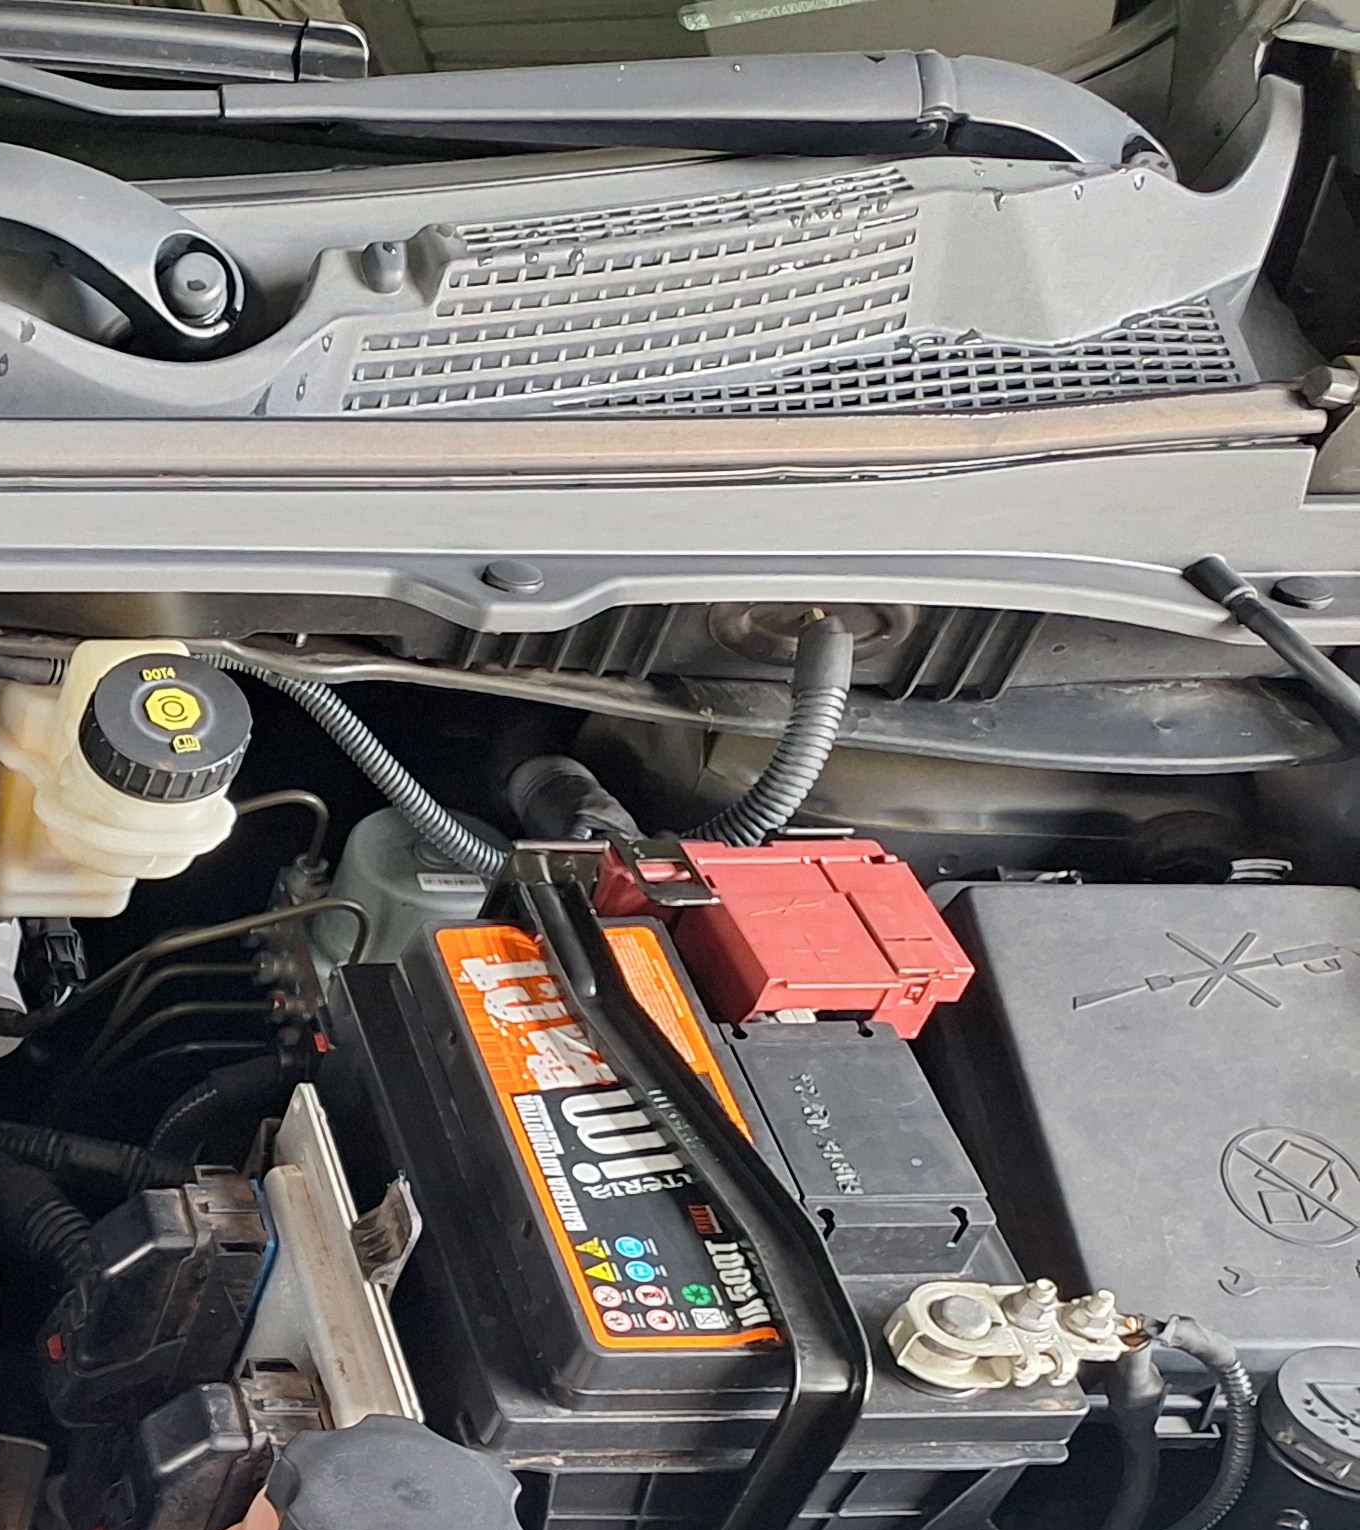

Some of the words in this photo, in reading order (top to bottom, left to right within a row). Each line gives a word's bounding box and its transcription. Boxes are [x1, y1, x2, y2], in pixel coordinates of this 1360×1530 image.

[141, 668, 177, 682] DOT4
[513, 1095, 565, 1176] AUTOMOTIVA
[547, 1177, 588, 1231] BATERIA
